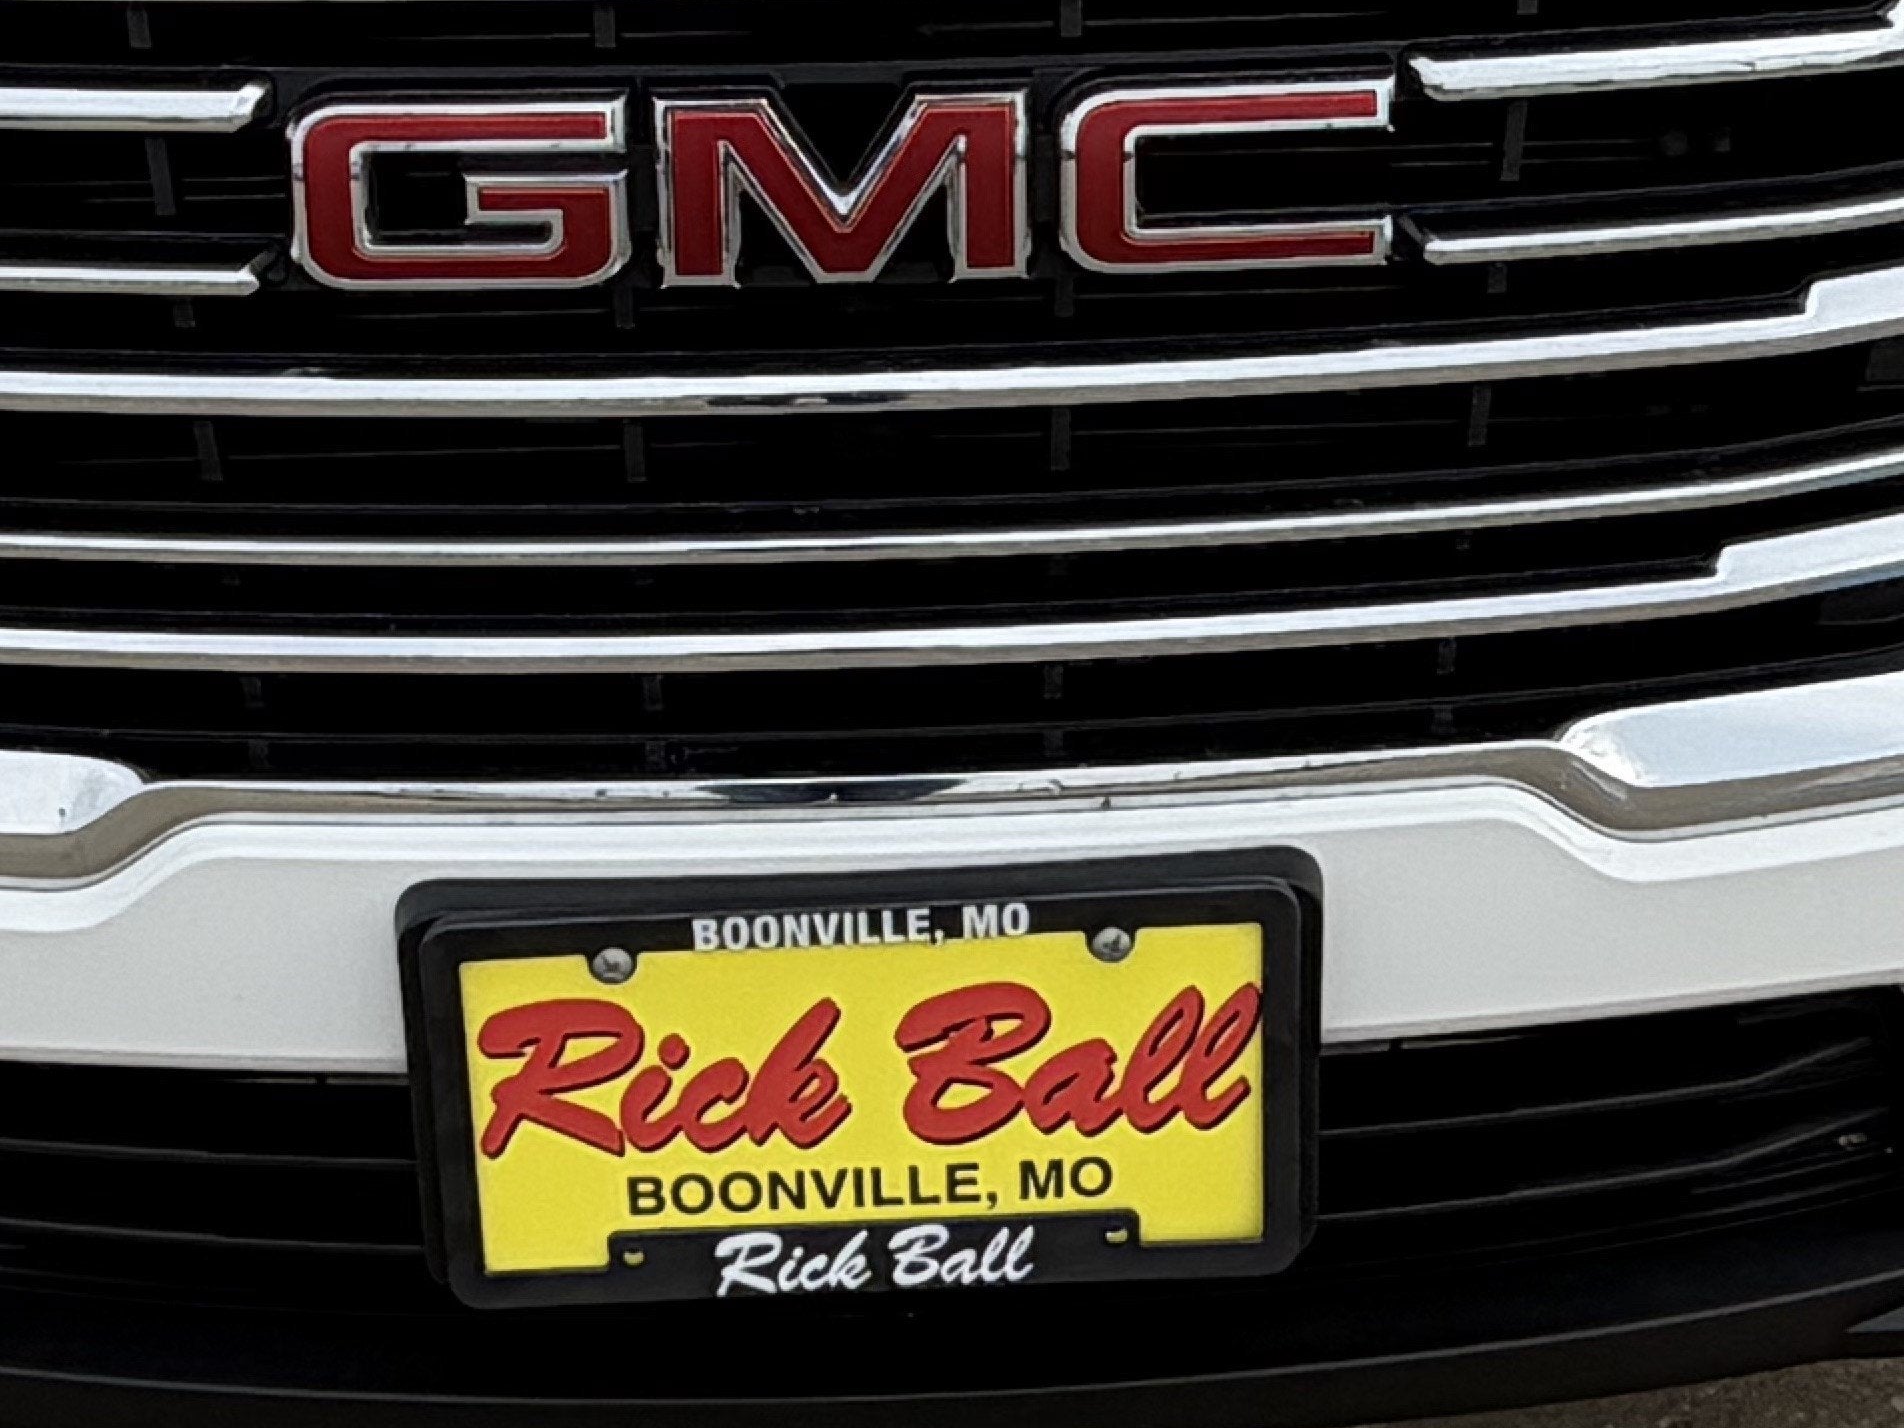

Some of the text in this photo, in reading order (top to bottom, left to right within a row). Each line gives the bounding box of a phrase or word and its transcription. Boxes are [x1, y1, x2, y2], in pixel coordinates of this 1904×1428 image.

[288, 80, 1394, 291] GMC
[692, 901, 1030, 951] BOONVILLE, MO
[477, 981, 1264, 1158] Rick Ball
[626, 1156, 1115, 1218] BOONVILLE, MO
[713, 1222, 1034, 1299] Rick Ball
